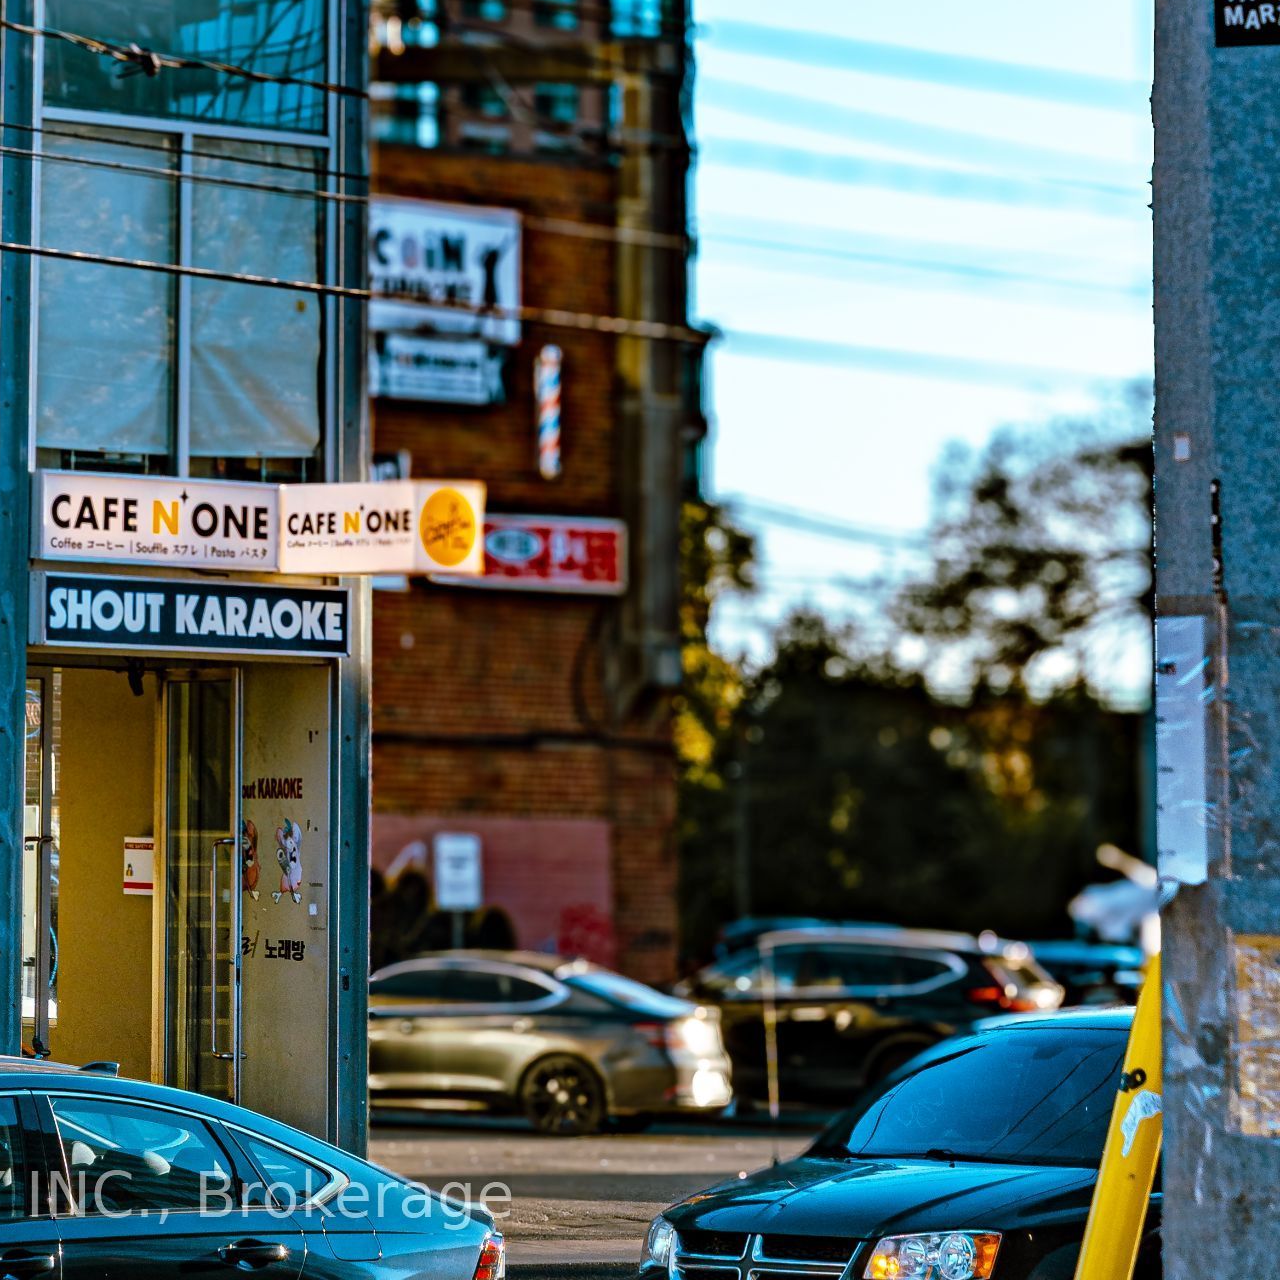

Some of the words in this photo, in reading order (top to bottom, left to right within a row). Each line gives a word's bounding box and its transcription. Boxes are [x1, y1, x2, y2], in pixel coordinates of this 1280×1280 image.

[1223, 4, 1280, 30] MAR
[51, 493, 138, 532] CAFE
[287, 513, 336, 535] CAFE
[50, 537, 82, 549] Coffee
[211, 546, 236, 557] Pasta
[49, 587, 165, 633] SHOUT
[175, 594, 344, 642] KARAOKE
[242, 782, 256, 799] out
[258, 778, 303, 799] KARAOKE
[265, 938, 306, 961] 노래방
